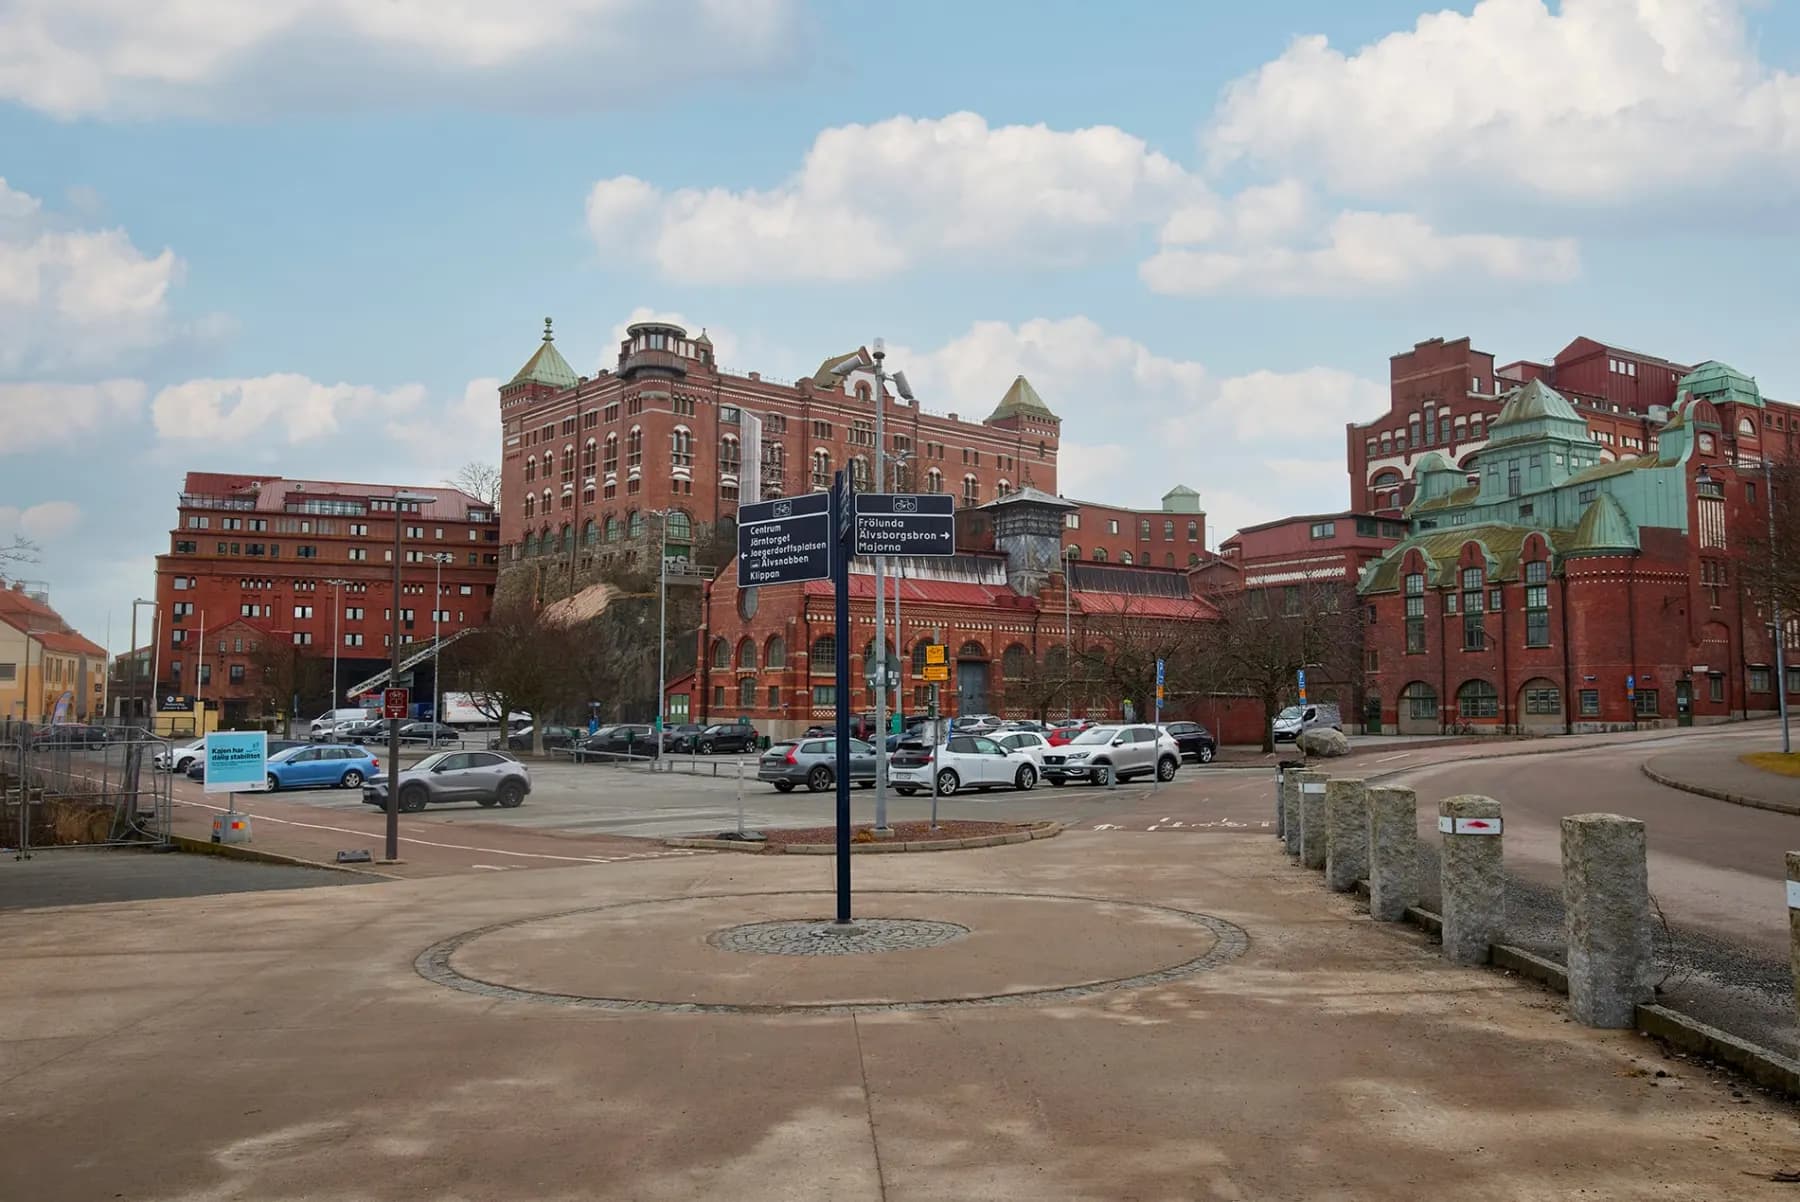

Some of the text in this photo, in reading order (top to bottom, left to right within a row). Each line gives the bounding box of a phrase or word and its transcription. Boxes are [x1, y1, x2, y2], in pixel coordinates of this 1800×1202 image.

[858, 518, 904, 528] Frölunda
[750, 524, 781, 535] Centrum
[859, 528, 936, 541] Älvsborgsbron
[750, 534, 790, 546] Järntorget
[750, 542, 826, 558] Jaegerdorffsplatsen
[858, 542, 901, 552] Majorna
[761, 555, 808, 568] Älvsnabben
[750, 570, 780, 580] Klippan
